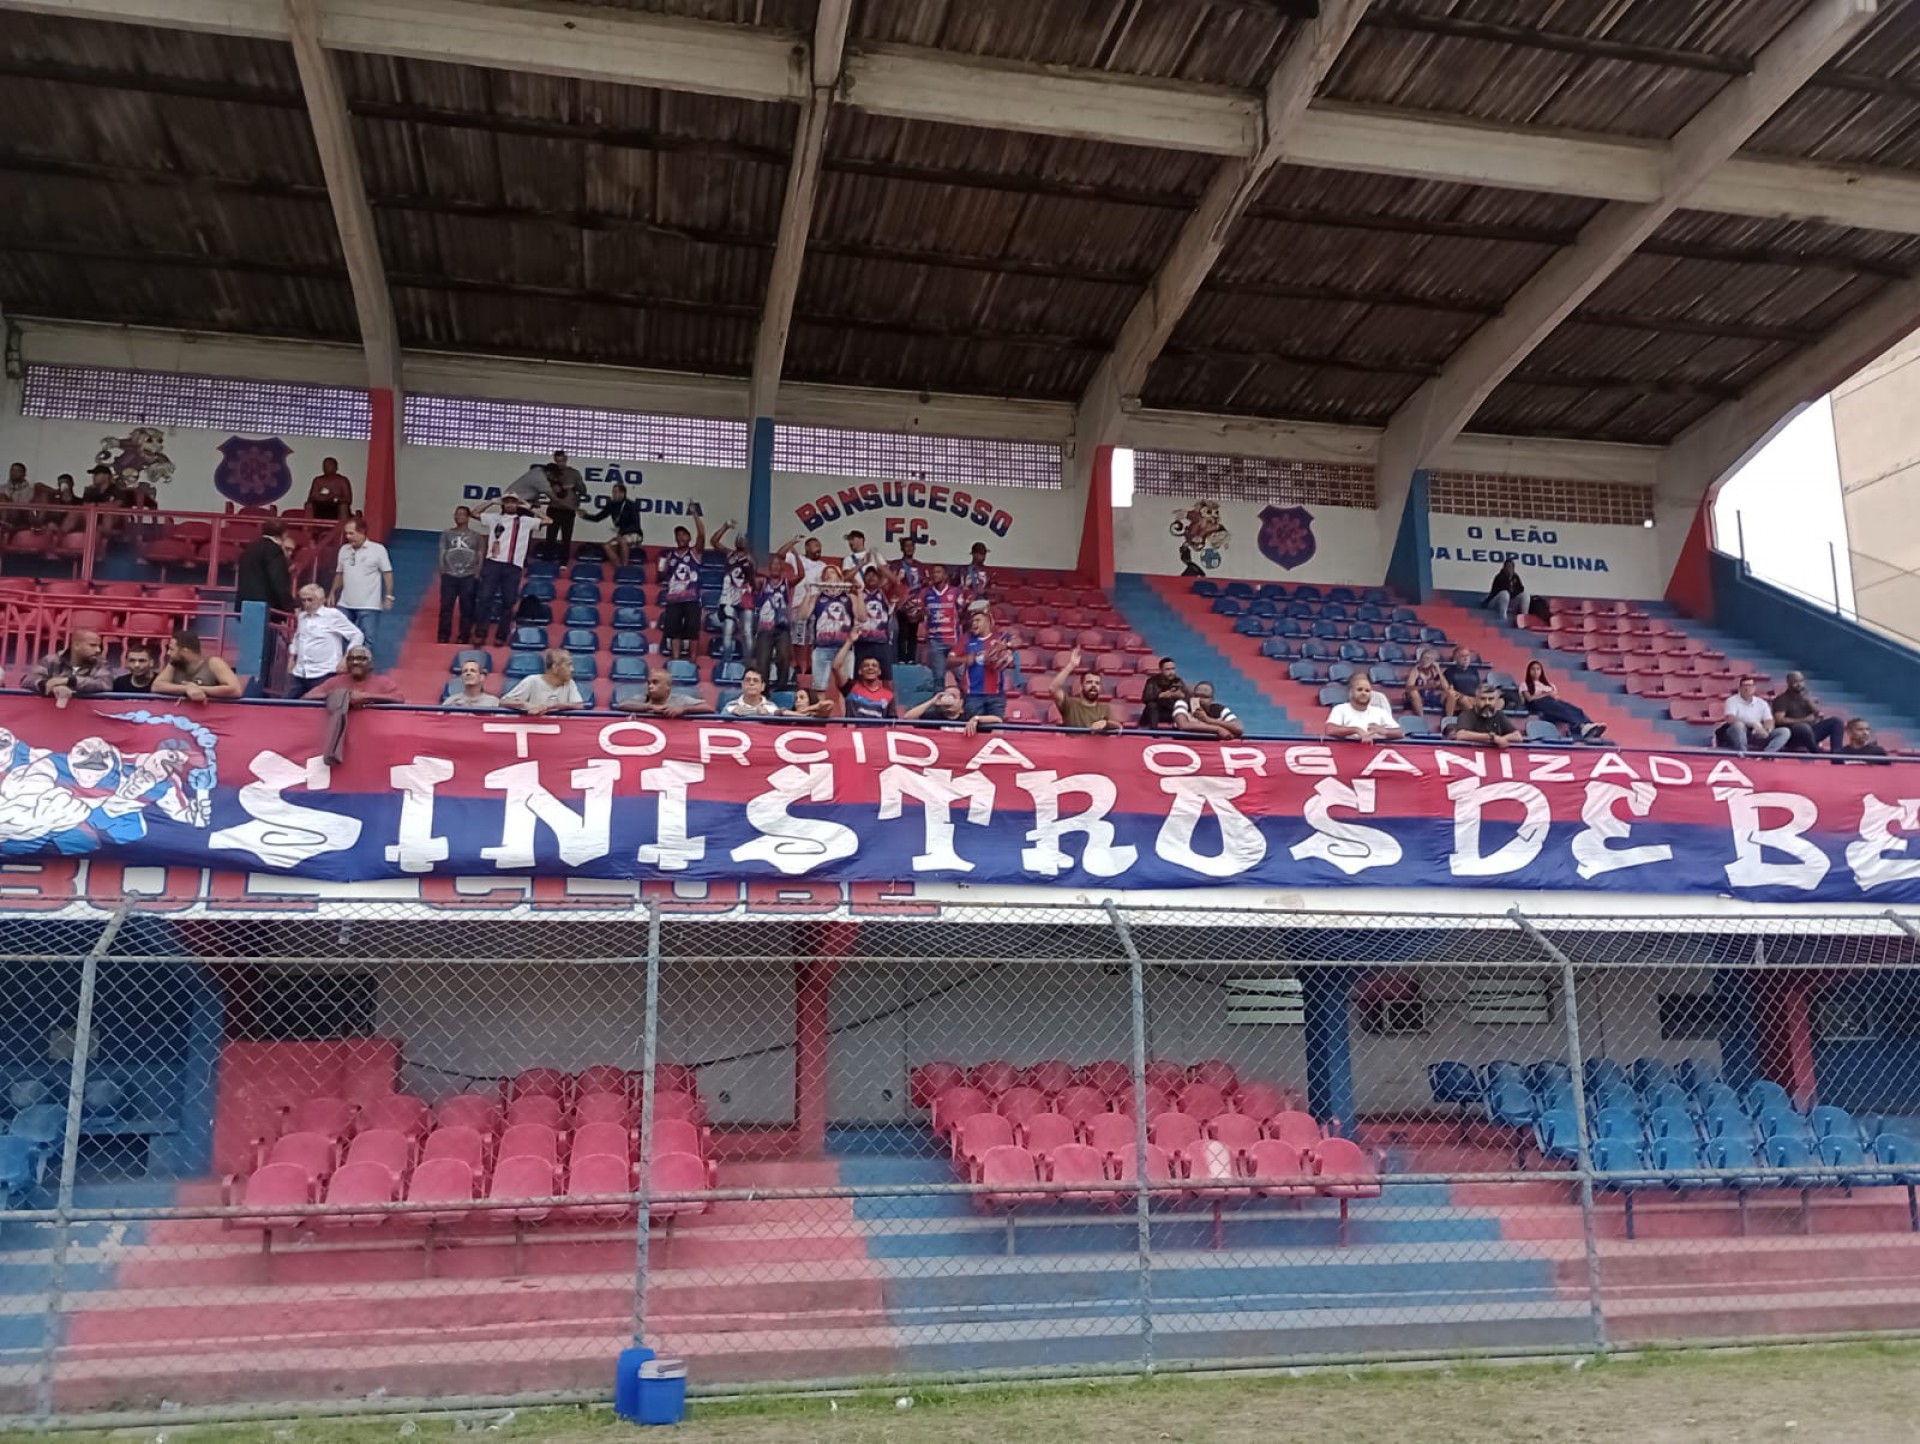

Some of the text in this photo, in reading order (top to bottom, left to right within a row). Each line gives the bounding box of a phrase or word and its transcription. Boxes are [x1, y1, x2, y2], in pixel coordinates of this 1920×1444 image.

[585, 463, 643, 485] EÃO
[463, 485, 502, 502] DA
[795, 481, 1014, 538] BONSUCESSO
[1467, 525, 1557, 544] O LEÃO
[1430, 547, 1609, 573] A LEOPOLDINA
[482, 721, 1754, 788] TORCIDA ORGANIZADA
[208, 750, 1404, 877] SINISTROS
[1446, 776, 1672, 880] DE
